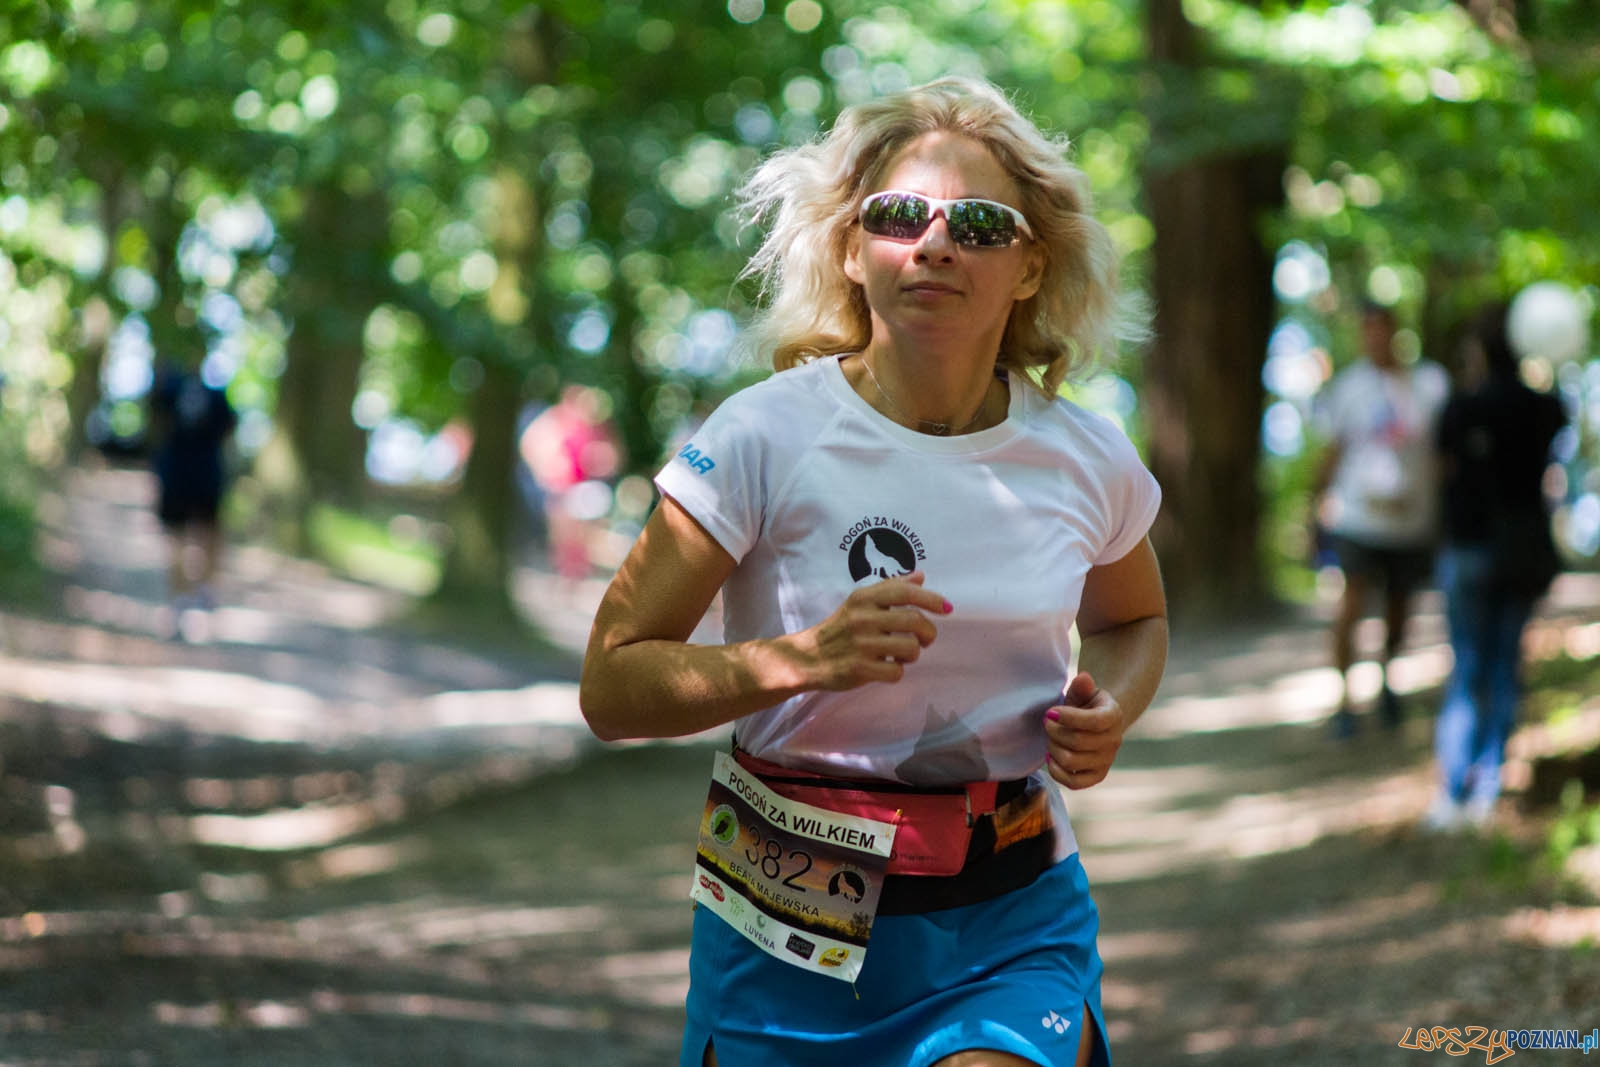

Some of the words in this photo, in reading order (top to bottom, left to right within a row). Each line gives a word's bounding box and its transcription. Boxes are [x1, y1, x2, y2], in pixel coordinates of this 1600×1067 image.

[839, 516, 872, 551] POGOŃ
[874, 516, 888, 526] ZA
[892, 518, 927, 560] WILKIEM
[728, 772, 767, 814] POGOŃ
[768, 806, 787, 827] ZA
[793, 815, 876, 850] WILKIEM
[745, 826, 813, 893] 382
[757, 882, 819, 917] MAJEWSKA
[744, 922, 775, 950] LUVENA
